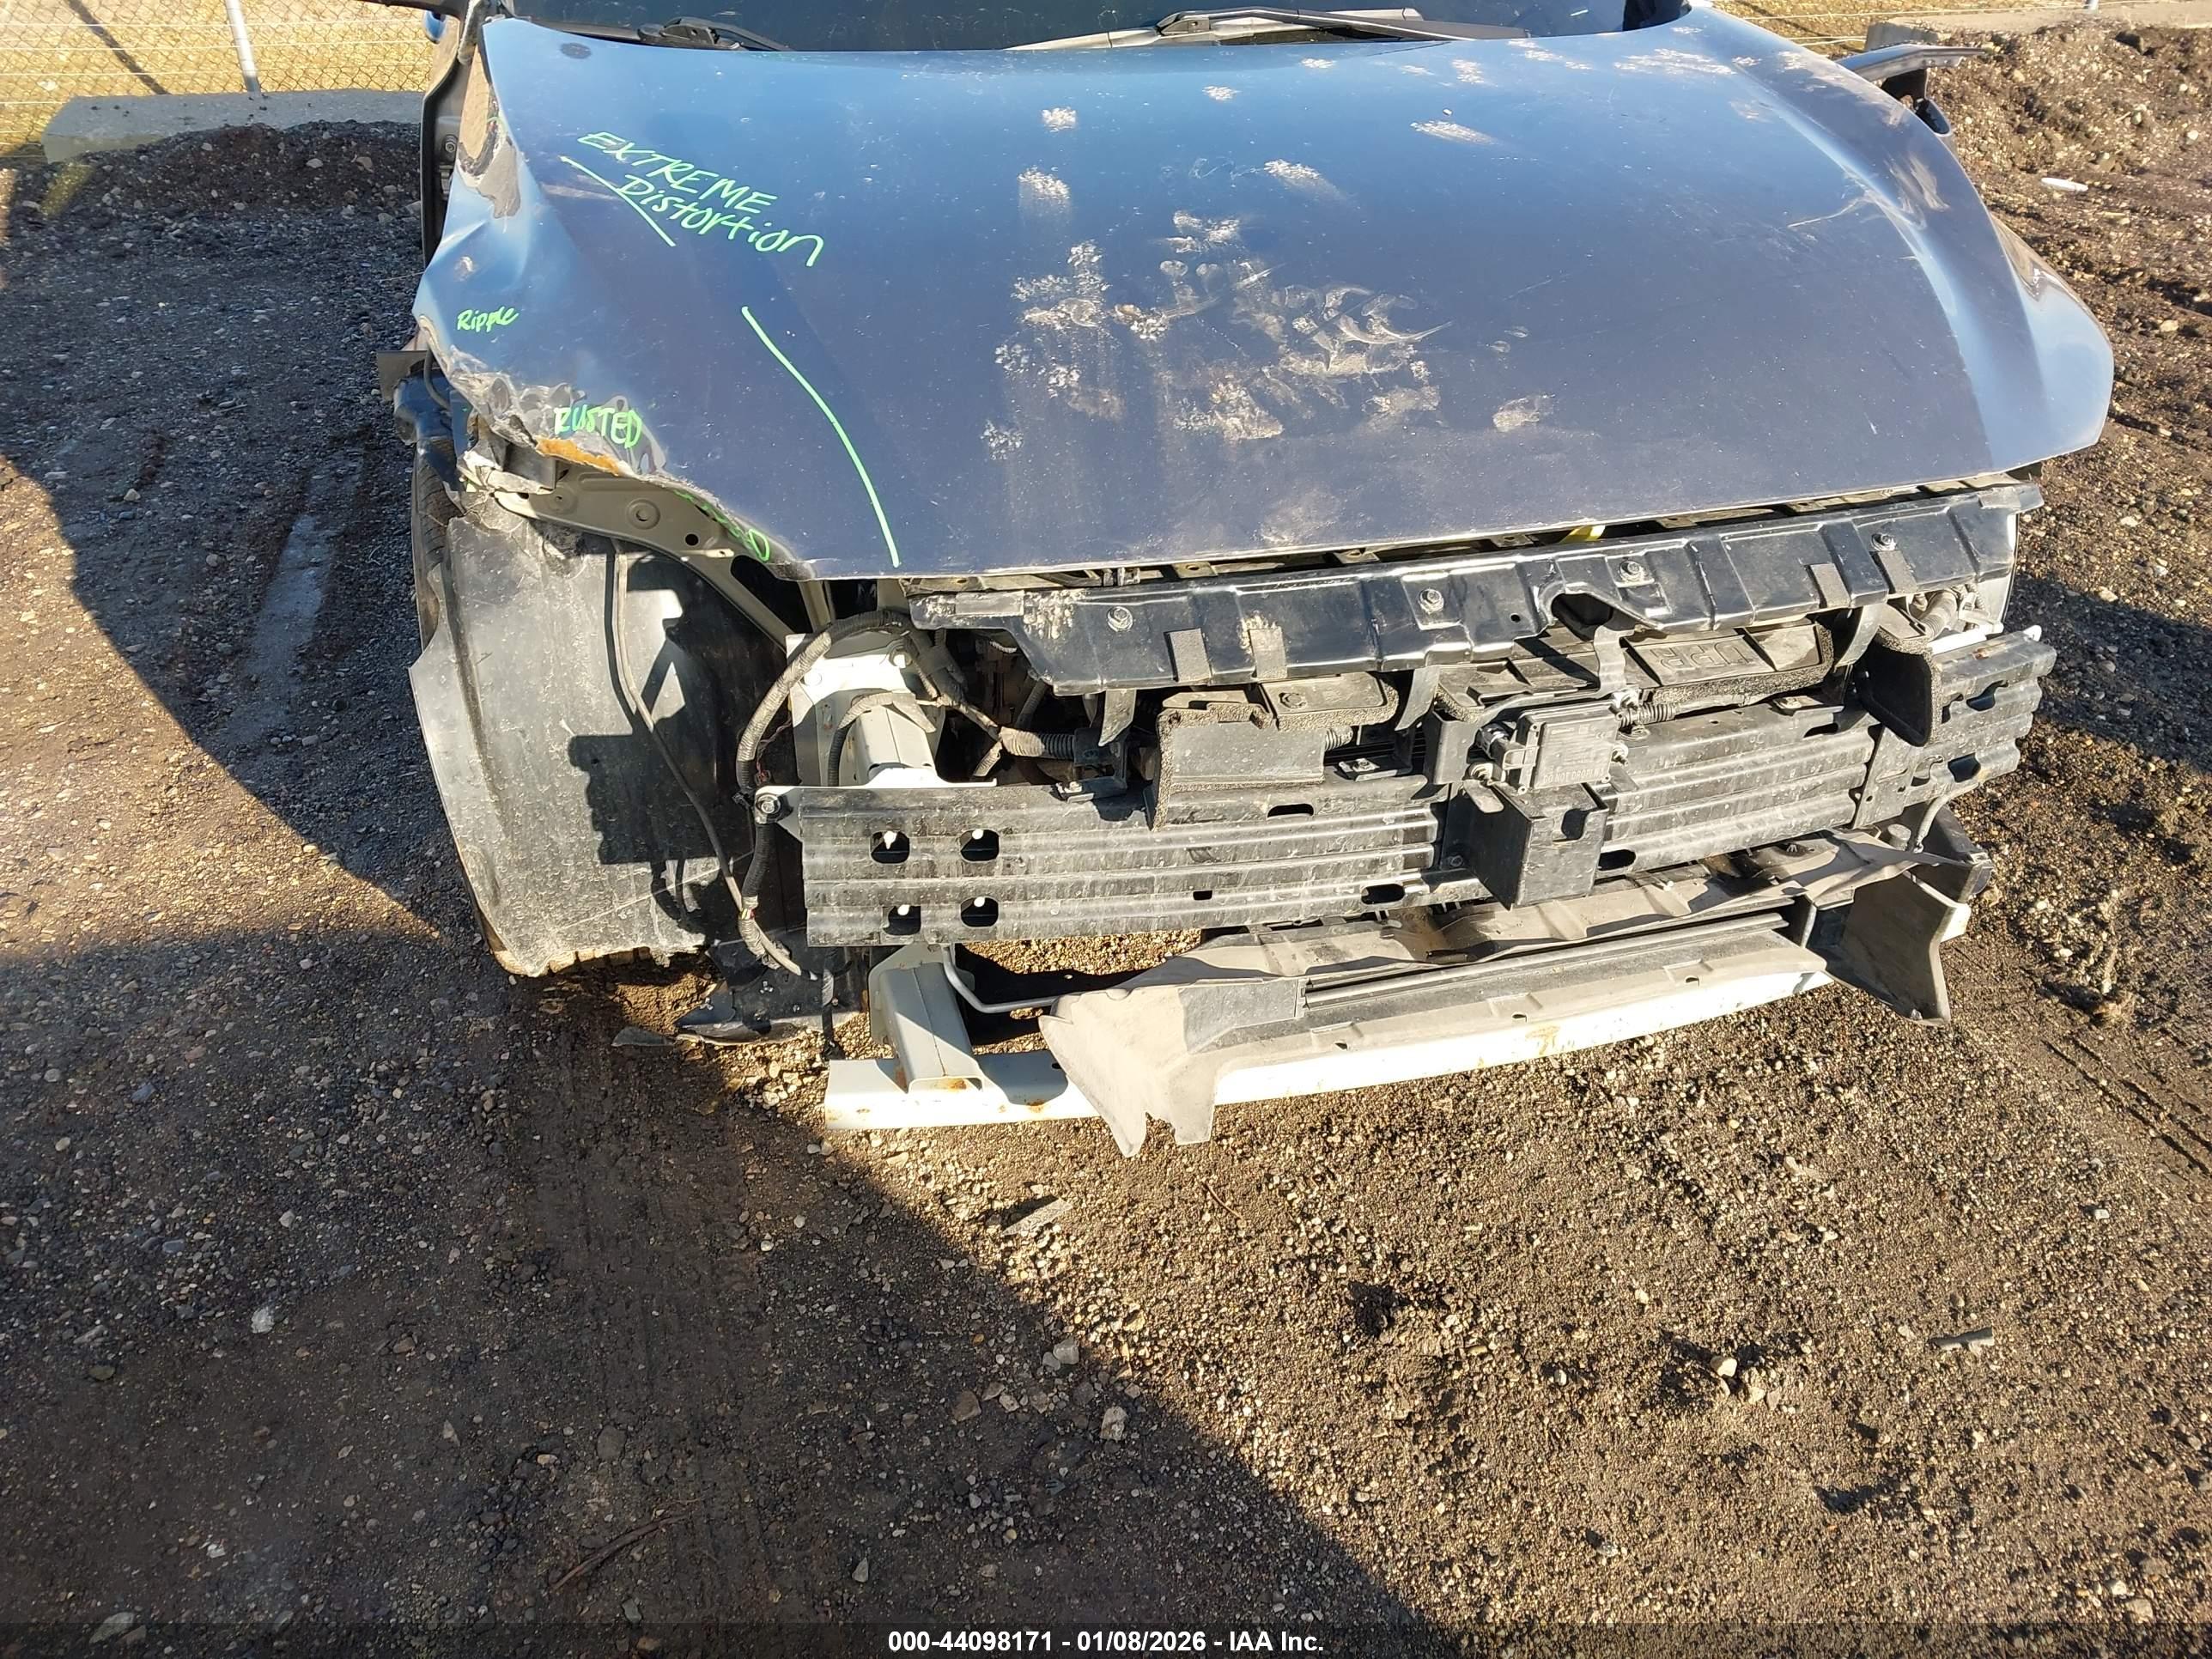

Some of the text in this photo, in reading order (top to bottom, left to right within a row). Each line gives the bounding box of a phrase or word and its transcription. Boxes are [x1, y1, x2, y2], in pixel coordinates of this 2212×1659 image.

[577, 131, 777, 214] EXTREME
[616, 174, 824, 267] Distortion
[457, 307, 520, 332] Ripple
[554, 404, 643, 449] RUSTED
